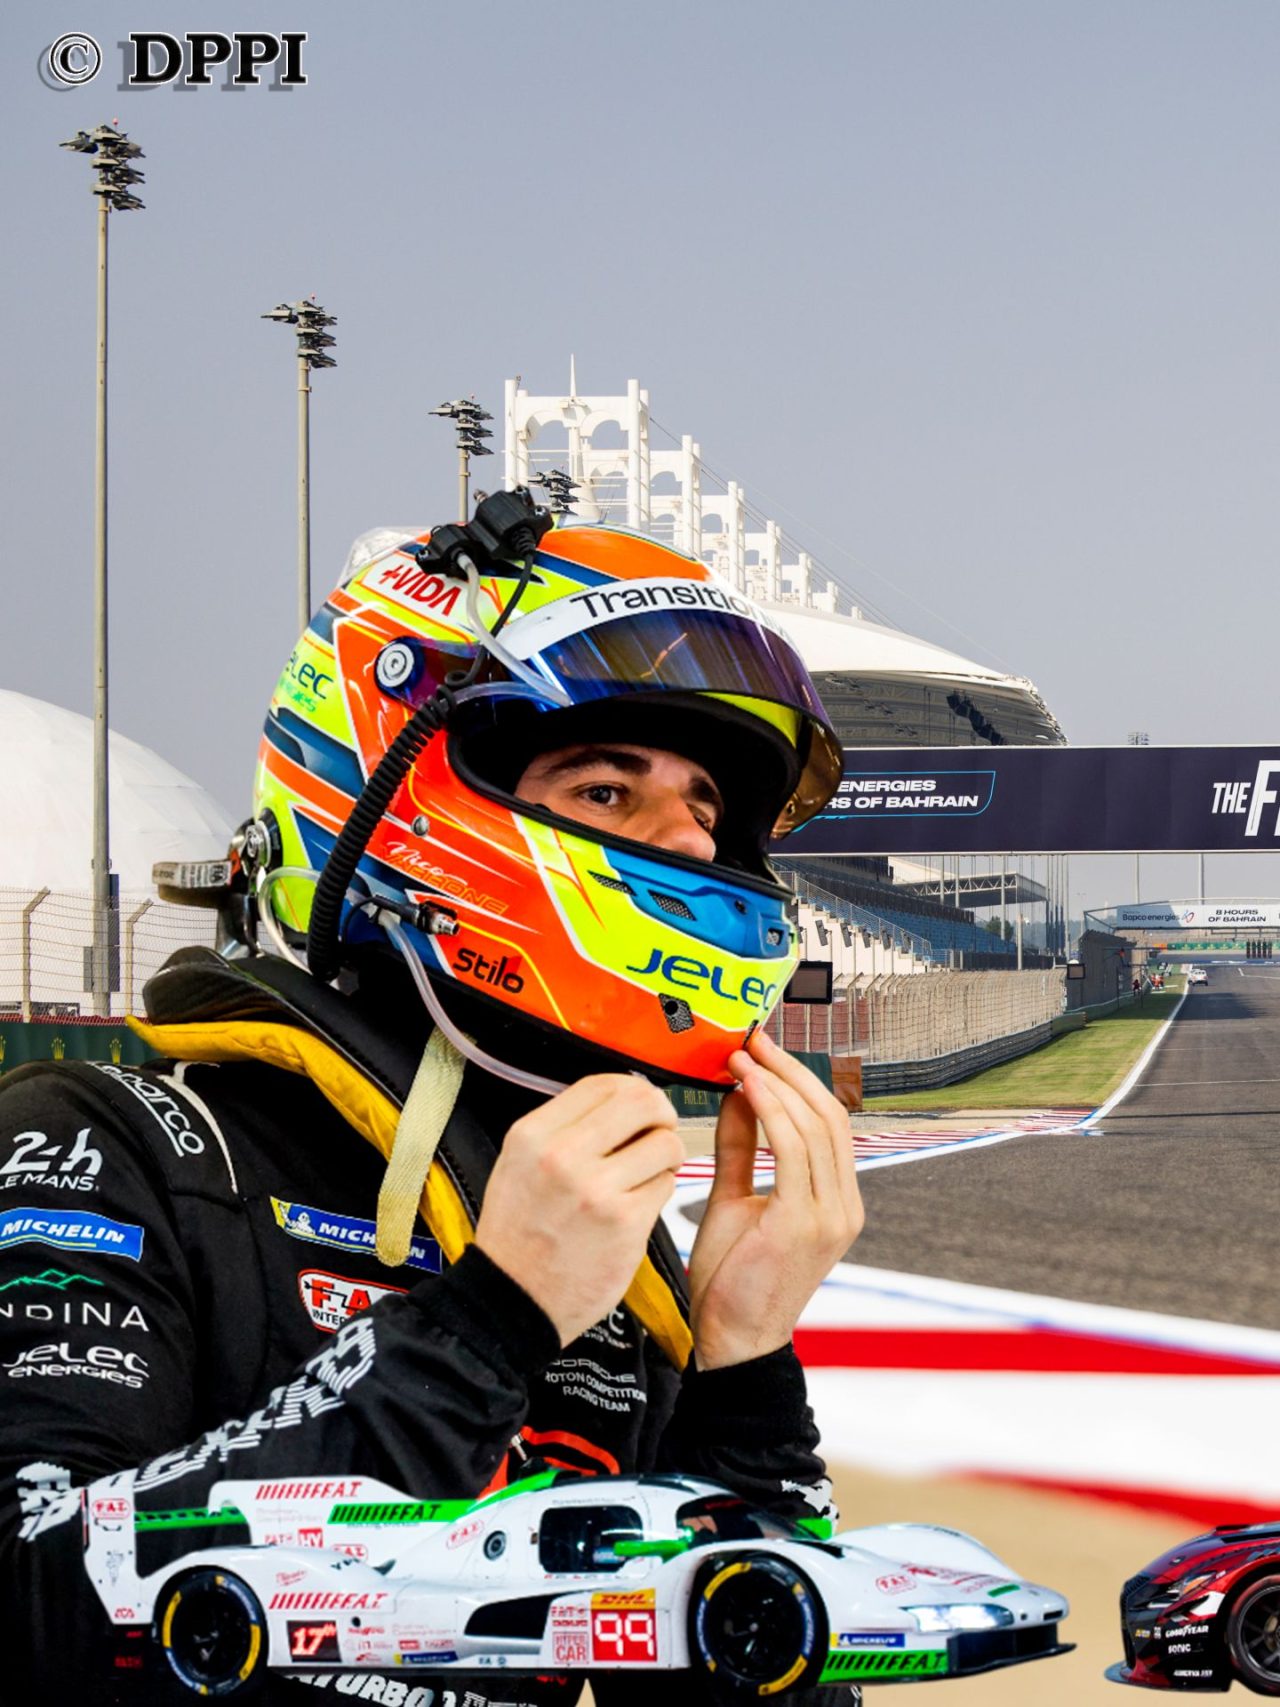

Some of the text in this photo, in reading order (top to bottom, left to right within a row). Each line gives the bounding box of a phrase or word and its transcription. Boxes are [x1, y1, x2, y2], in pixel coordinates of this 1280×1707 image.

[854, 796, 881, 809] OF
[885, 795, 979, 809] BAHRAIN
[1211, 782, 1251, 814] THE
[1122, 913, 1148, 923] Bapco
[1223, 915, 1267, 923] BAHRAIN
[1224, 908, 1259, 916] HOURS
[453, 947, 525, 994] Stilo
[22, 1172, 94, 1192] MANS
[1, 1219, 126, 1244] MICHELIN
[318, 1221, 426, 1261] MICHN
[599, 1396, 631, 1413] TEAM
[600, 1593, 647, 1605] DHL
[594, 1612, 654, 1657] 99
[1165, 1624, 1210, 1638] GOODYEAR
[556, 1645, 587, 1661] CAR
